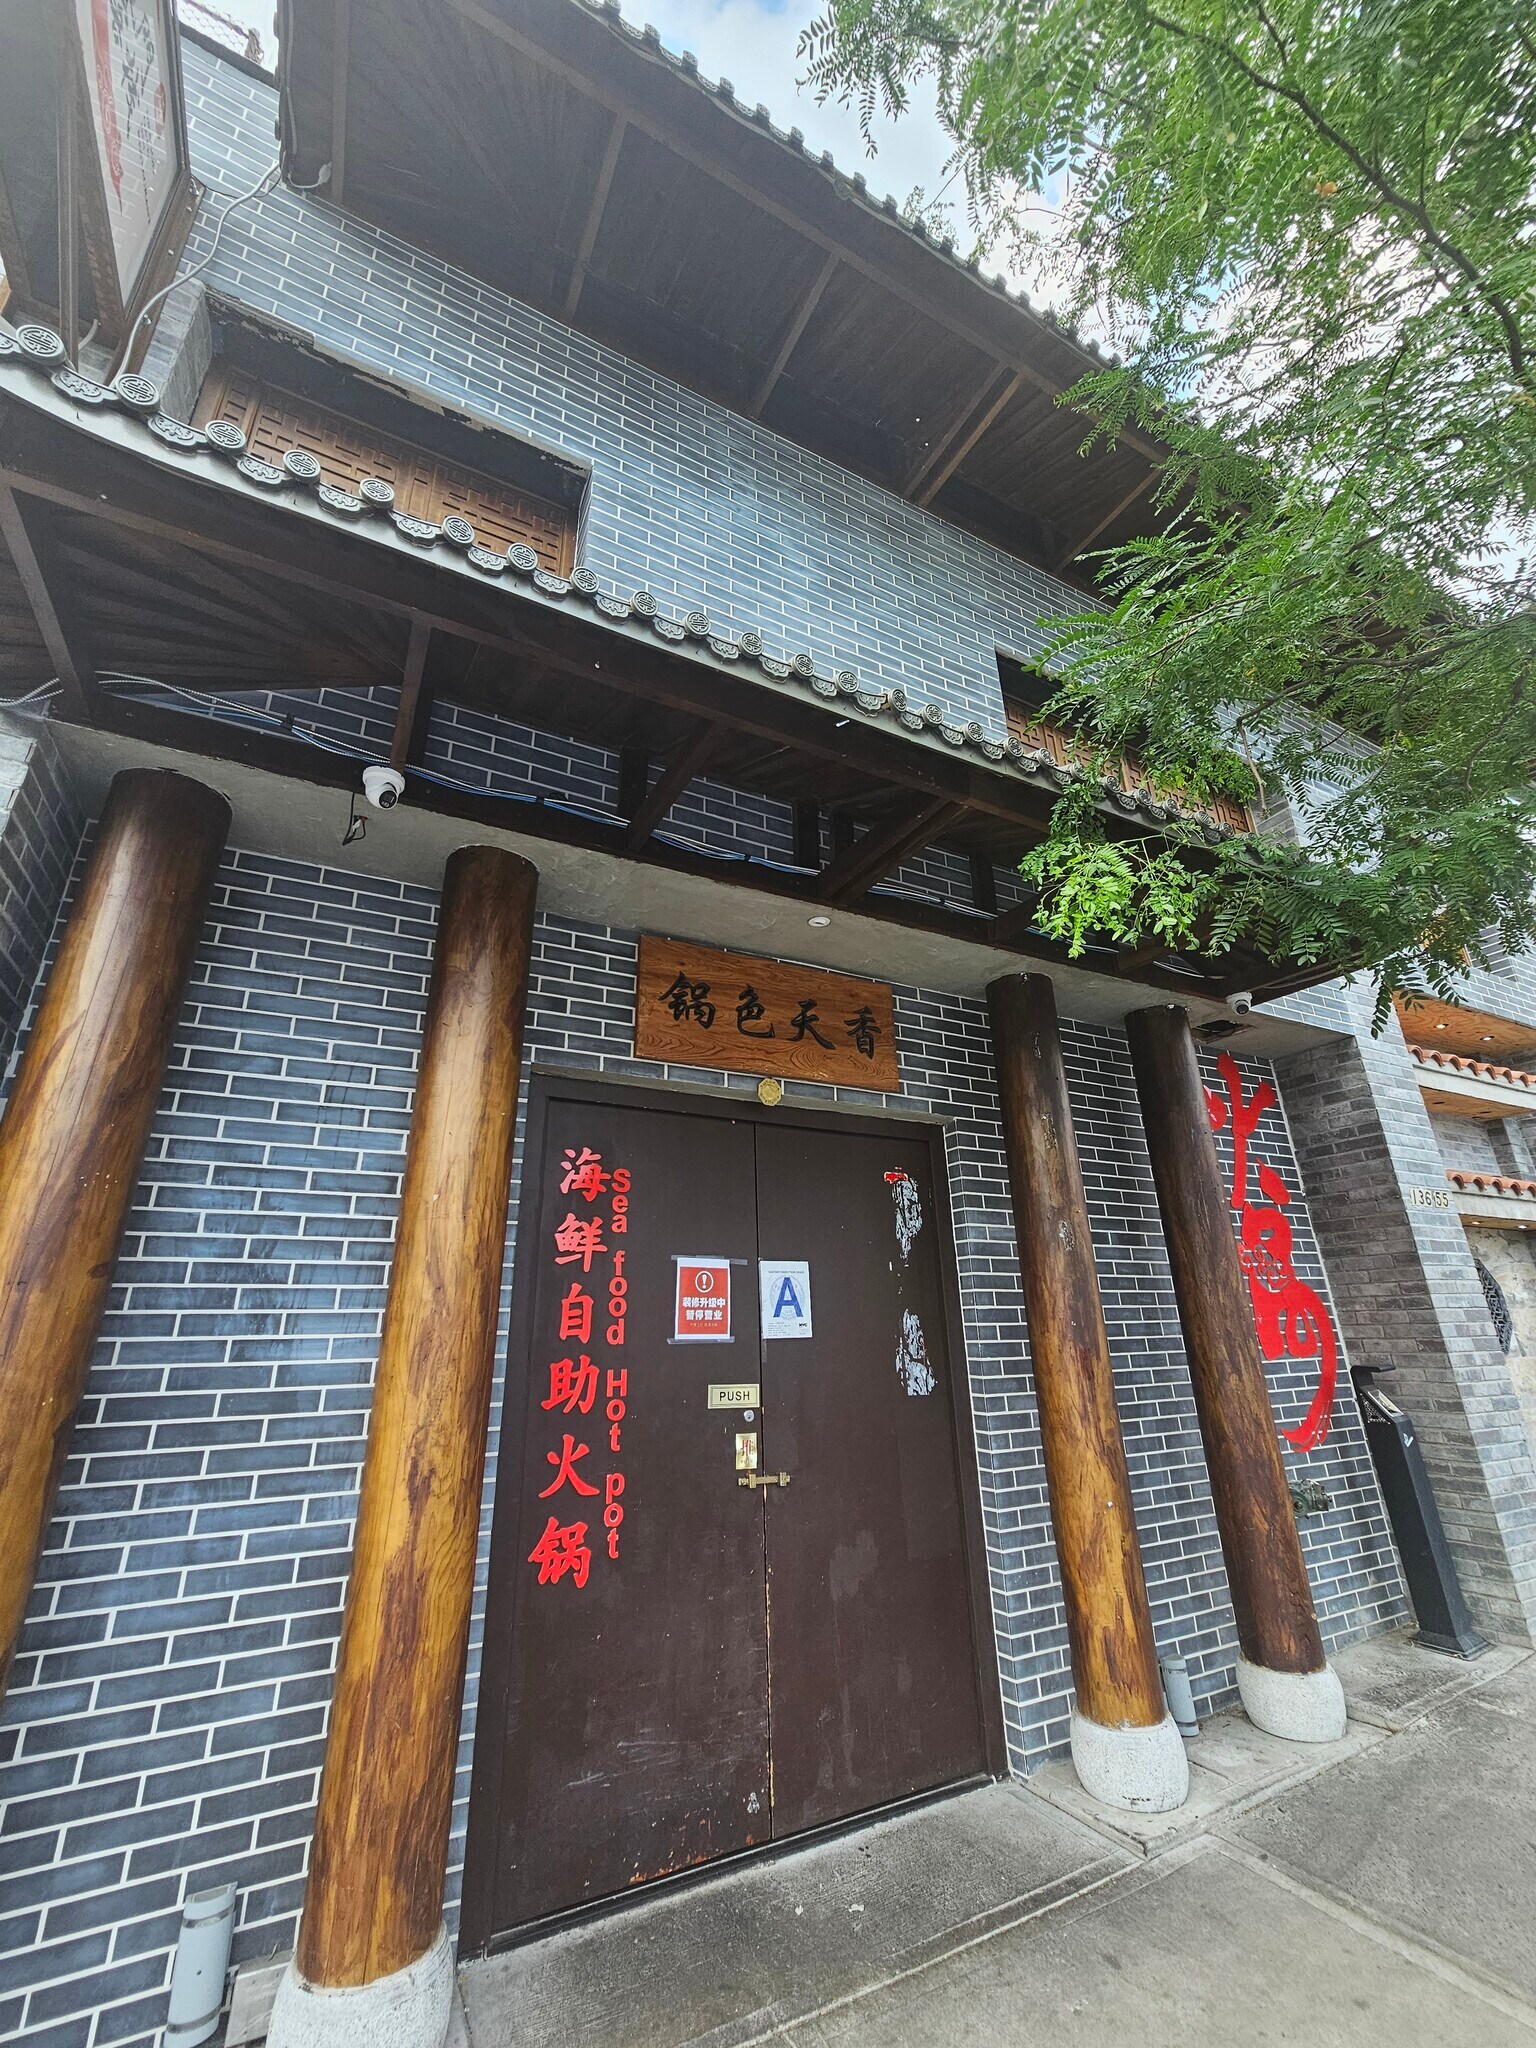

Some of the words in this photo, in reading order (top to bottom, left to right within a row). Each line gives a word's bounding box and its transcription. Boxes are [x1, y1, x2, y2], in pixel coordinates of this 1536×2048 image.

[658, 971, 882, 1060] 锅色天香
[1412, 1189, 1450, 1207] 13655
[682, 1296, 727, 1308] 装修升级中
[685, 1309, 723, 1320] 暂停营业
[772, 1277, 804, 1318] A
[526, 1147, 611, 1589] 海鲜自助火锅
[606, 1369, 628, 1452] Hot
[719, 1390, 750, 1402] PUSH
[603, 1472, 626, 1559] pot
